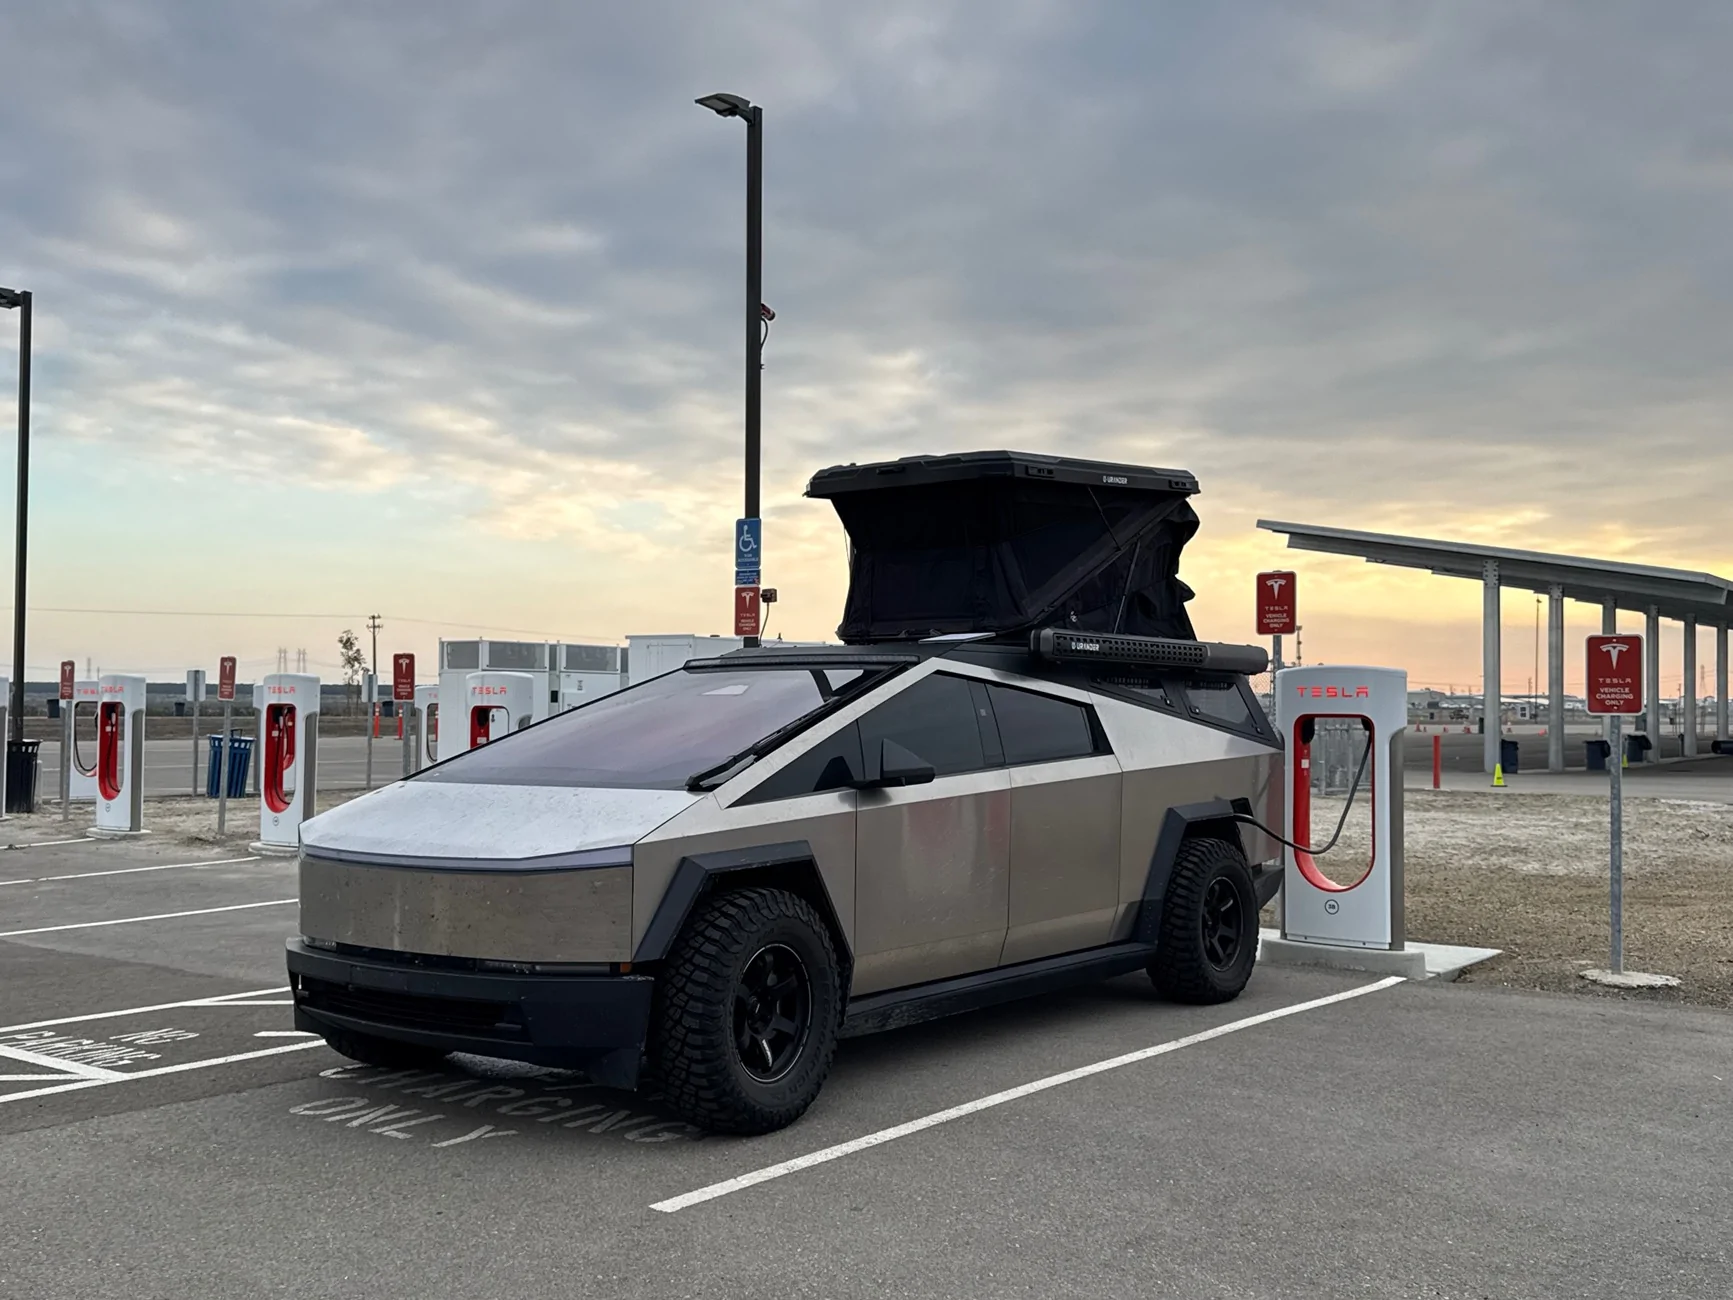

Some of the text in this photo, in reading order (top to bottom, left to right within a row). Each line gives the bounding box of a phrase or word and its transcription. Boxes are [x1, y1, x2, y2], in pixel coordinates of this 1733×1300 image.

[472, 686, 507, 695] TESLA
[1296, 686, 1368, 698] TESLA
[288, 1097, 519, 1148] ONLY
